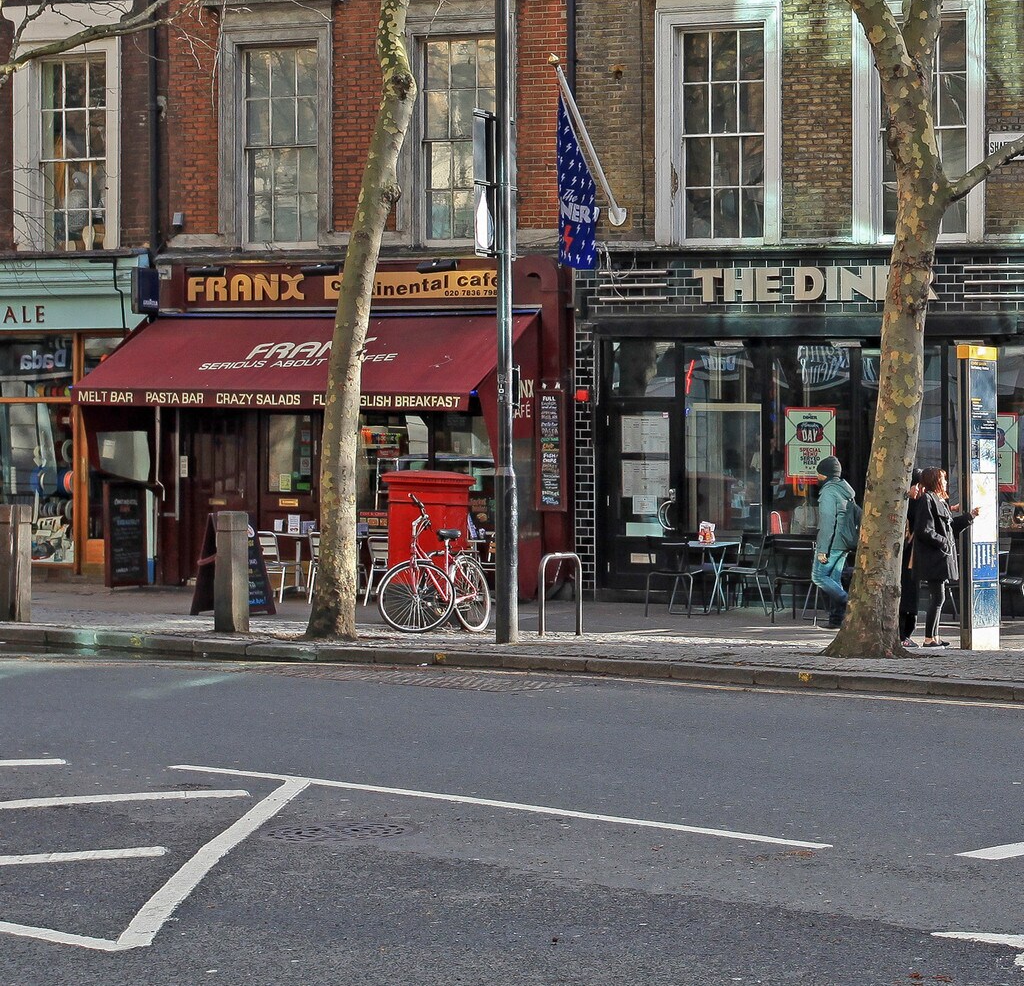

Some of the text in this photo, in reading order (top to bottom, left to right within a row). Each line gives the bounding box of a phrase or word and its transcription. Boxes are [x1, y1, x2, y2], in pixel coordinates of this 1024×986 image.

[187, 273, 304, 302] FRANX
[331, 275, 448, 296] cinental
[693, 267, 783, 303] THE
[3, 305, 45, 324] ALE
[198, 352, 398, 371] SERIOUS ABOUT FEE
[78, 391, 107, 402] MELT
[110, 391, 133, 403] BAR
[145, 392, 178, 403] PASTA
[182, 393, 204, 404] BAR
[216, 393, 253, 405] CRAZY
[256, 394, 301, 406] SALADS
[360, 395, 391, 407] GLISH
[395, 395, 461, 408] BREAKFAST
[512, 400, 531, 419] AFÉ
[801, 429, 818, 442] DAY
